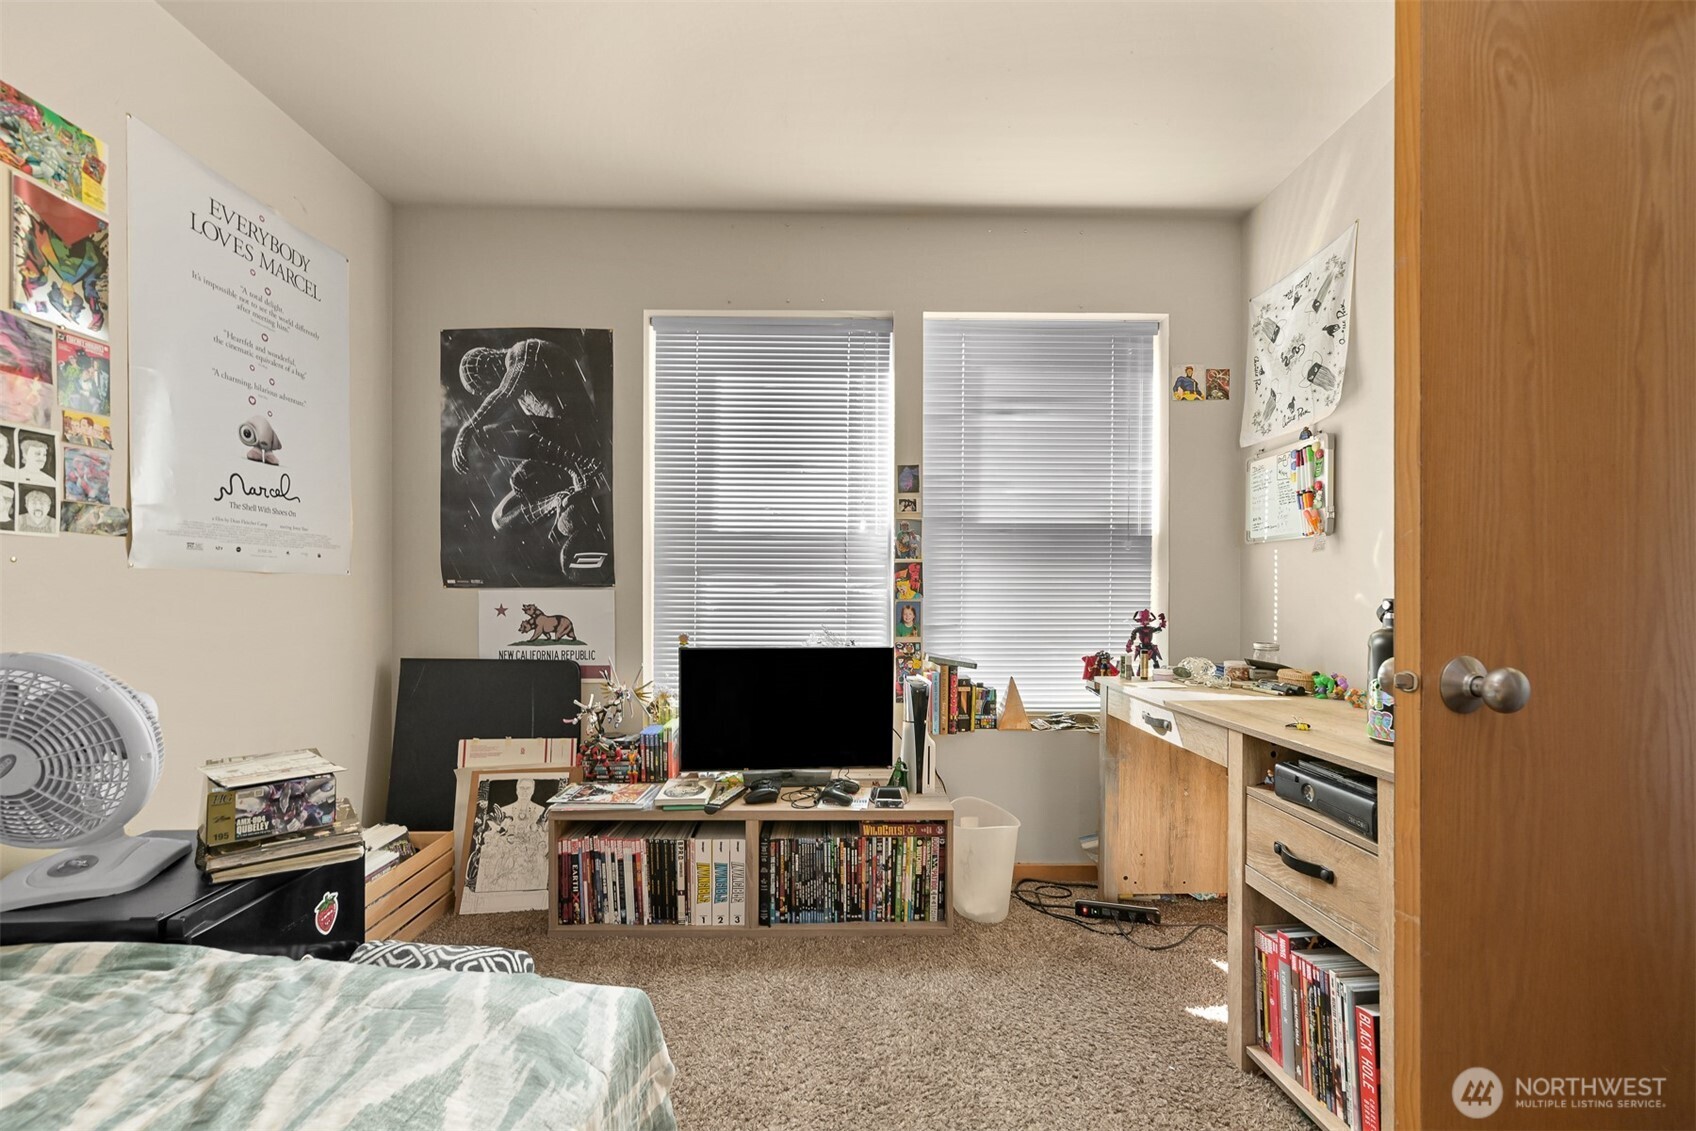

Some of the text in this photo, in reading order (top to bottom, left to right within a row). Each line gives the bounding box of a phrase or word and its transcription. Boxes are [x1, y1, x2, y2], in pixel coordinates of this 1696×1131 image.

[209, 197, 311, 273] EVERYBODY
[190, 211, 321, 302] LOVES MARCEL
[249, 291, 263, 303] total
[203, 278, 238, 299] impossible
[239, 295, 250, 306] not
[251, 301, 258, 310] to
[259, 304, 268, 313] see
[268, 307, 278, 318] the
[278, 315, 294, 328] world
[294, 321, 320, 341] differently
[236, 303, 251, 315] after
[252, 310, 276, 328] meeting
[213, 335, 224, 346] the
[225, 341, 254, 358] cinematic
[255, 354, 284, 371] equivalent
[284, 365, 291, 373] of
[255, 344, 267, 355] and
[253, 383, 278, 399] hilarious
[214, 472, 301, 503] Marcel
[229, 501, 297, 518] The Shell With Shoes On
[498, 649, 596, 661] NEW CALIFORNIA REPUBLIC
[236, 815, 266, 827] AMX-004
[213, 832, 230, 841] 195
[696, 862, 711, 904] INVINCIBLE
[714, 862, 728, 904] INVINCIBLE
[730, 861, 745, 903] INVINCIBLE
[572, 893, 580, 903] X
[701, 916, 706, 924] 1
[717, 916, 724, 924] 2
[734, 916, 741, 924] 3
[1279, 937, 1287, 960] MARVEL
[1358, 1012, 1375, 1094] BLACK HOLE
[1363, 1099, 1371, 1126] BURNS
[1369, 1098, 1377, 1131] CHARLE
